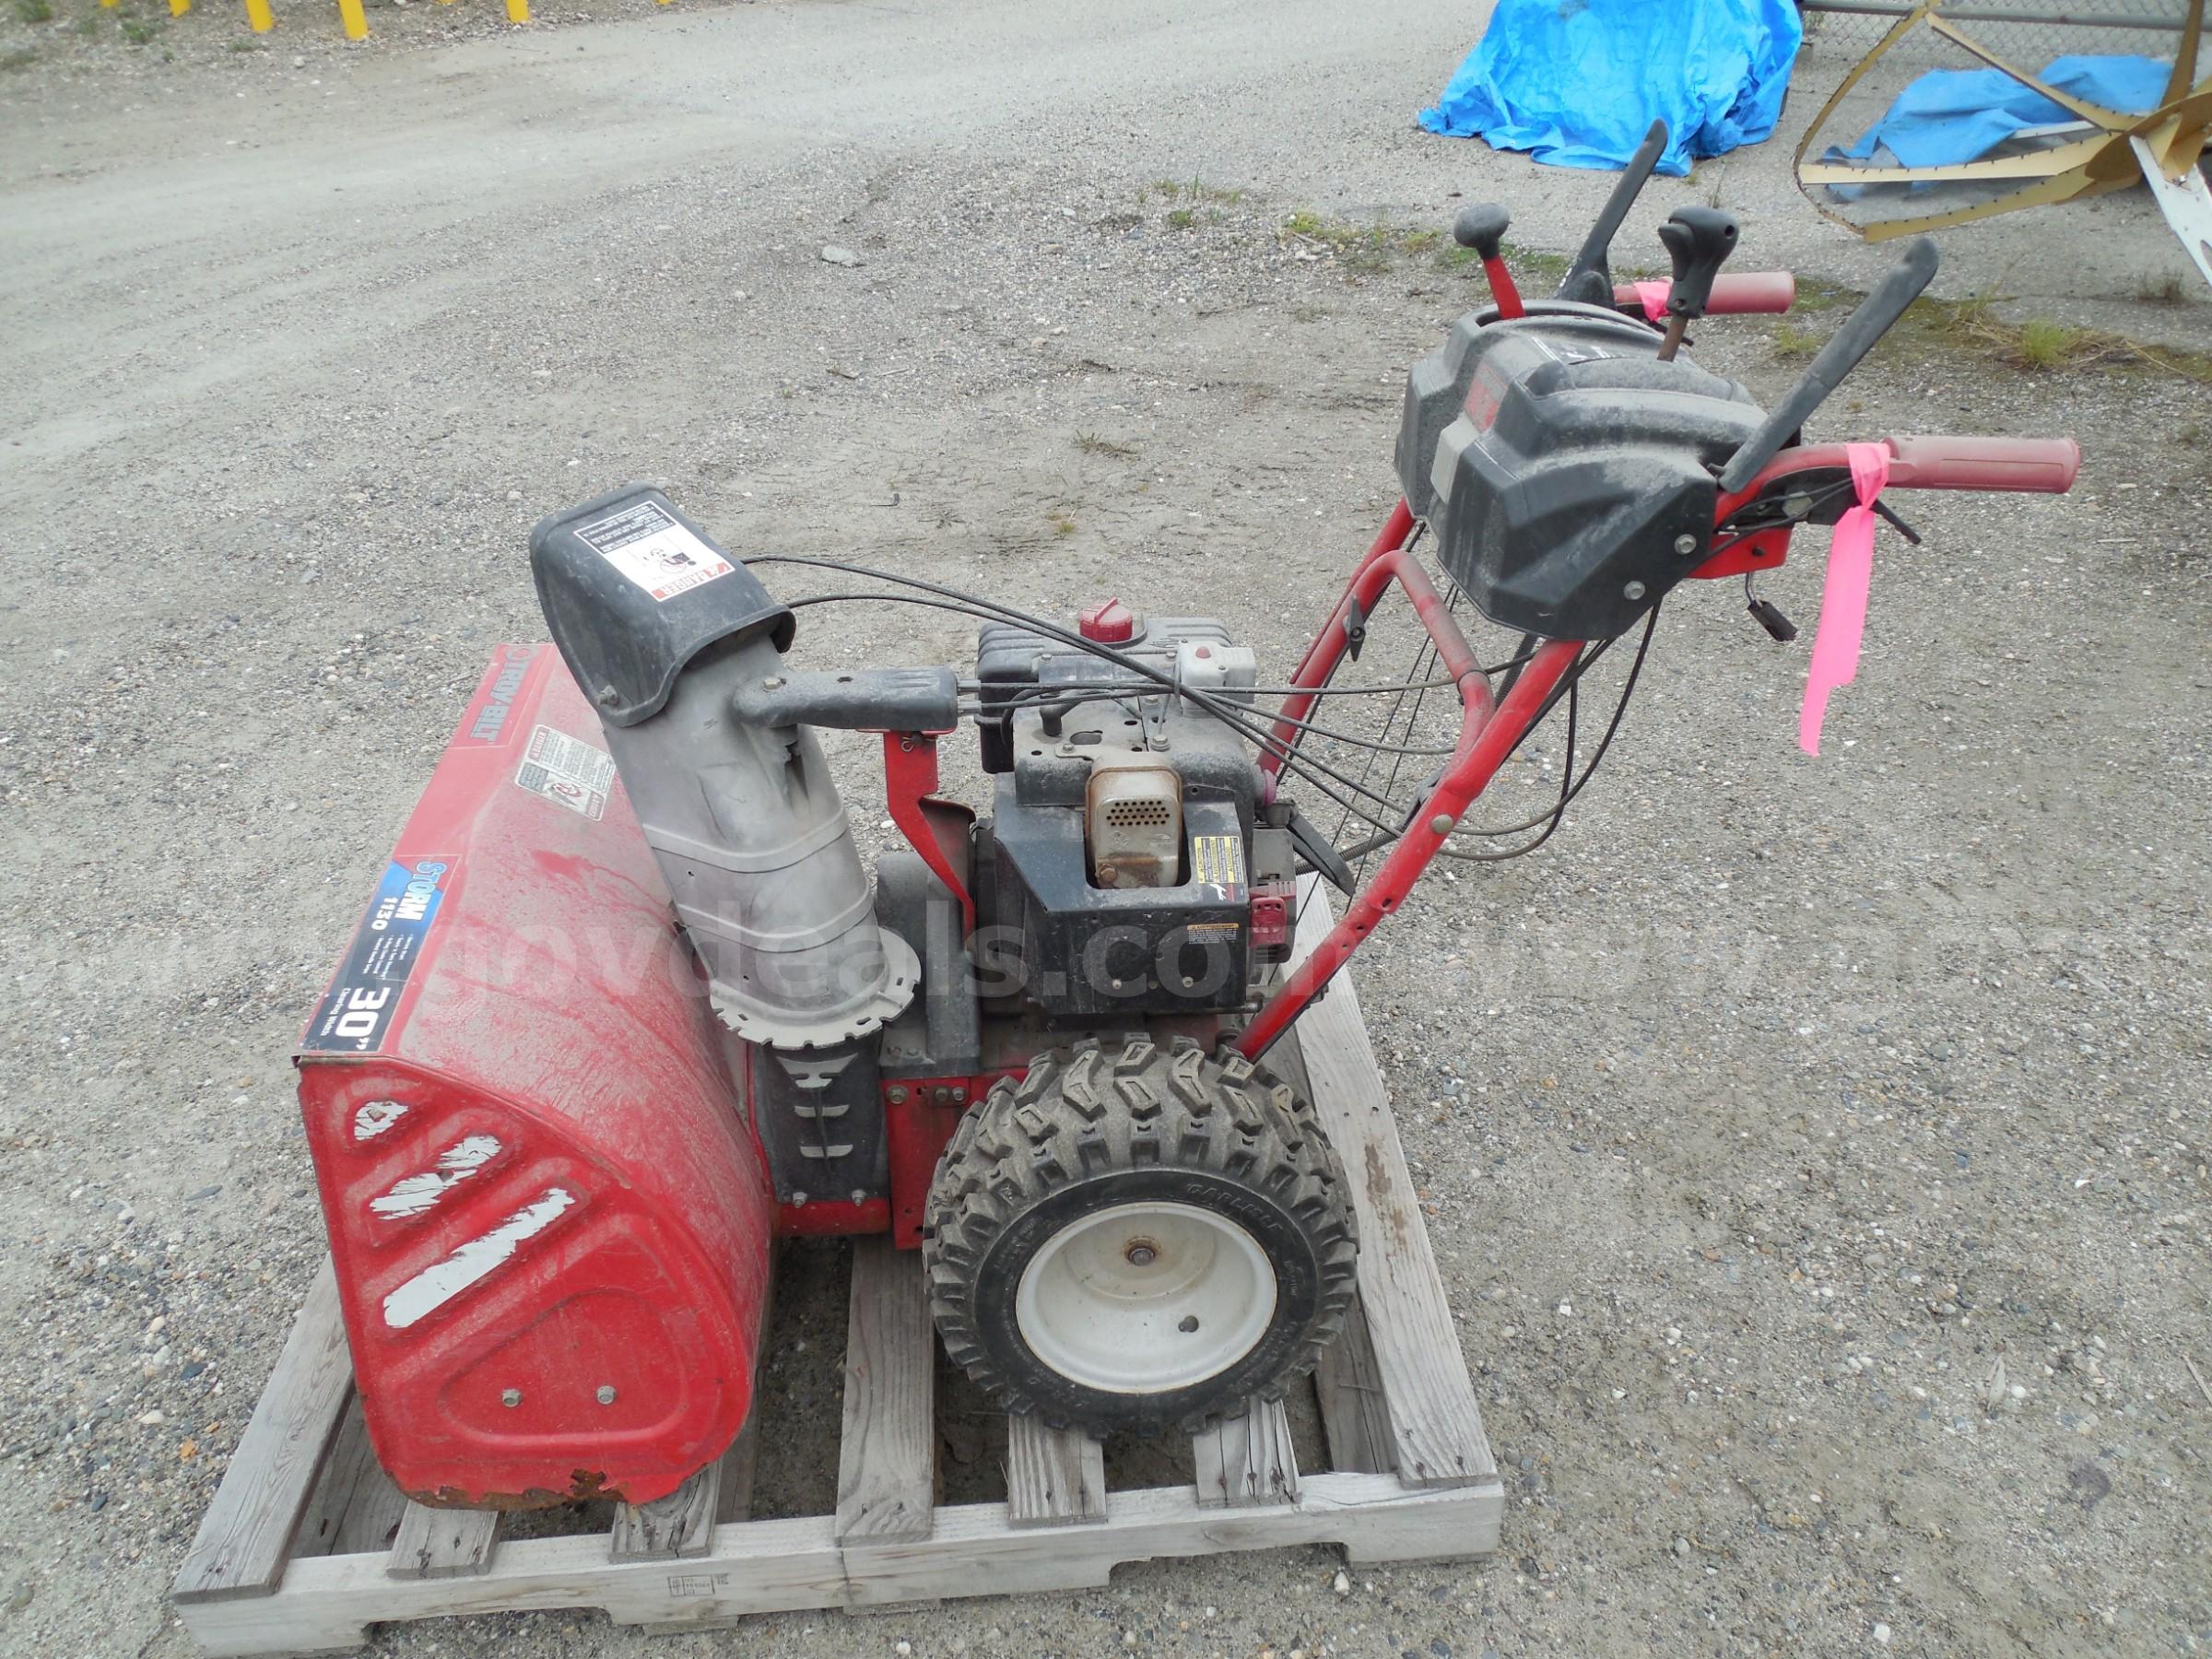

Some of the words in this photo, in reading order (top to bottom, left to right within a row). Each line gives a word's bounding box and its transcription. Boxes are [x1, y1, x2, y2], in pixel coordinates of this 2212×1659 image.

[394, 861, 448, 921] STORM
[371, 897, 399, 931] 1130
[329, 988, 351, 1015] Clearing
[320, 1016, 338, 1036] Width
